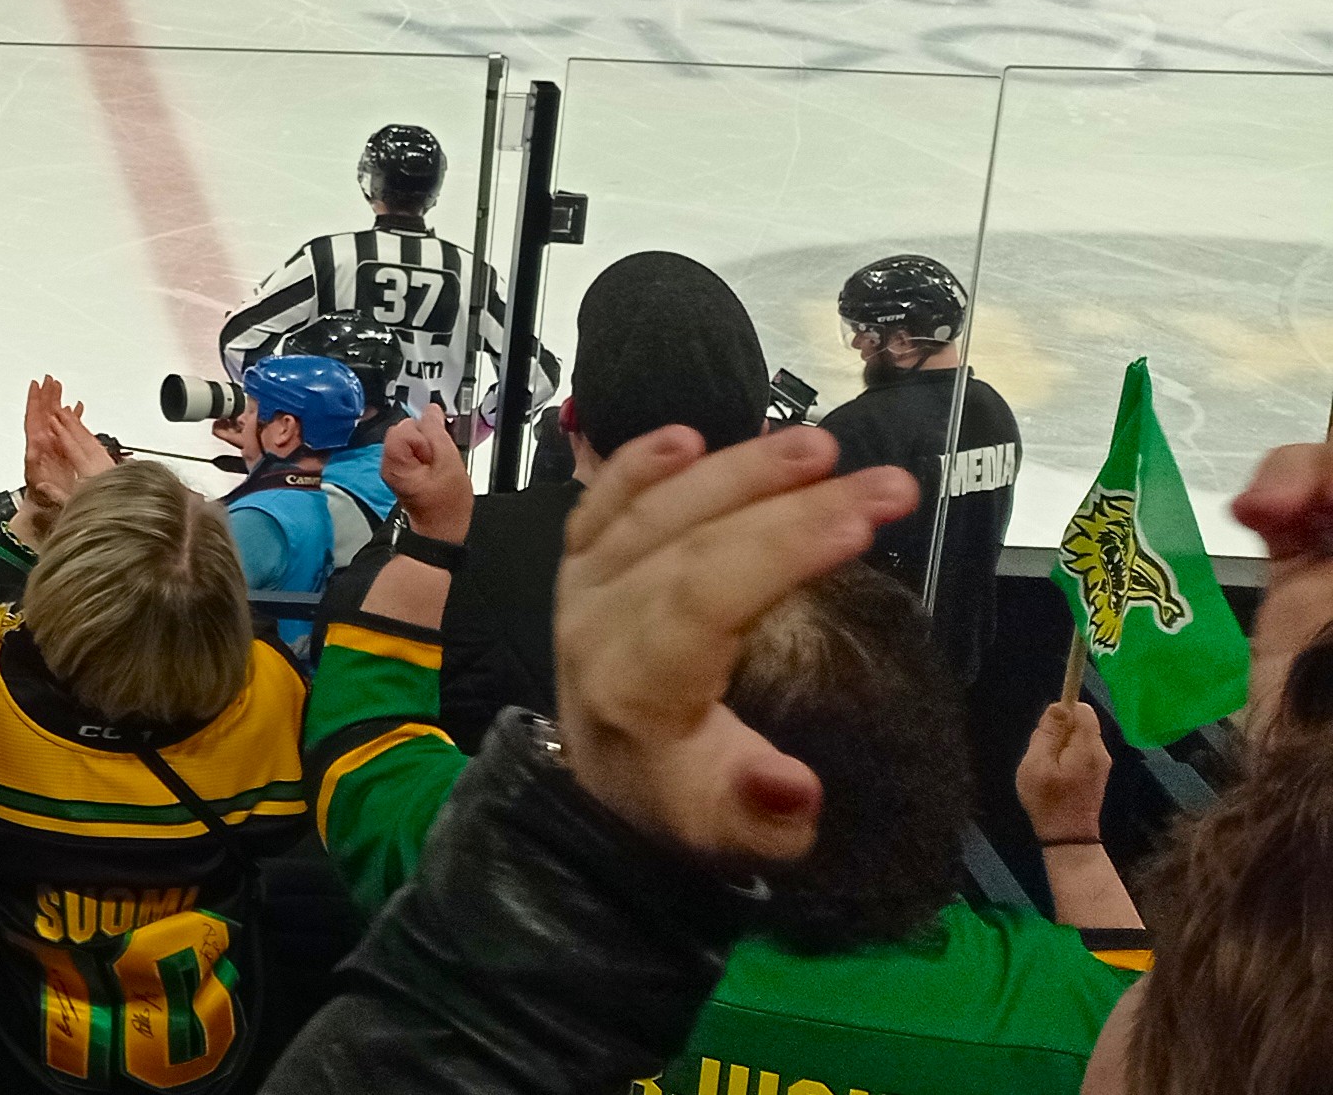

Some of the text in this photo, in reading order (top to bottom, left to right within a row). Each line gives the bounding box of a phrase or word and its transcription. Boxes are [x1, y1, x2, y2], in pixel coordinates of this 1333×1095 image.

[373, 266, 445, 328] 37
[35, 885, 200, 945] SUOMI
[37, 909, 237, 1090] 10
